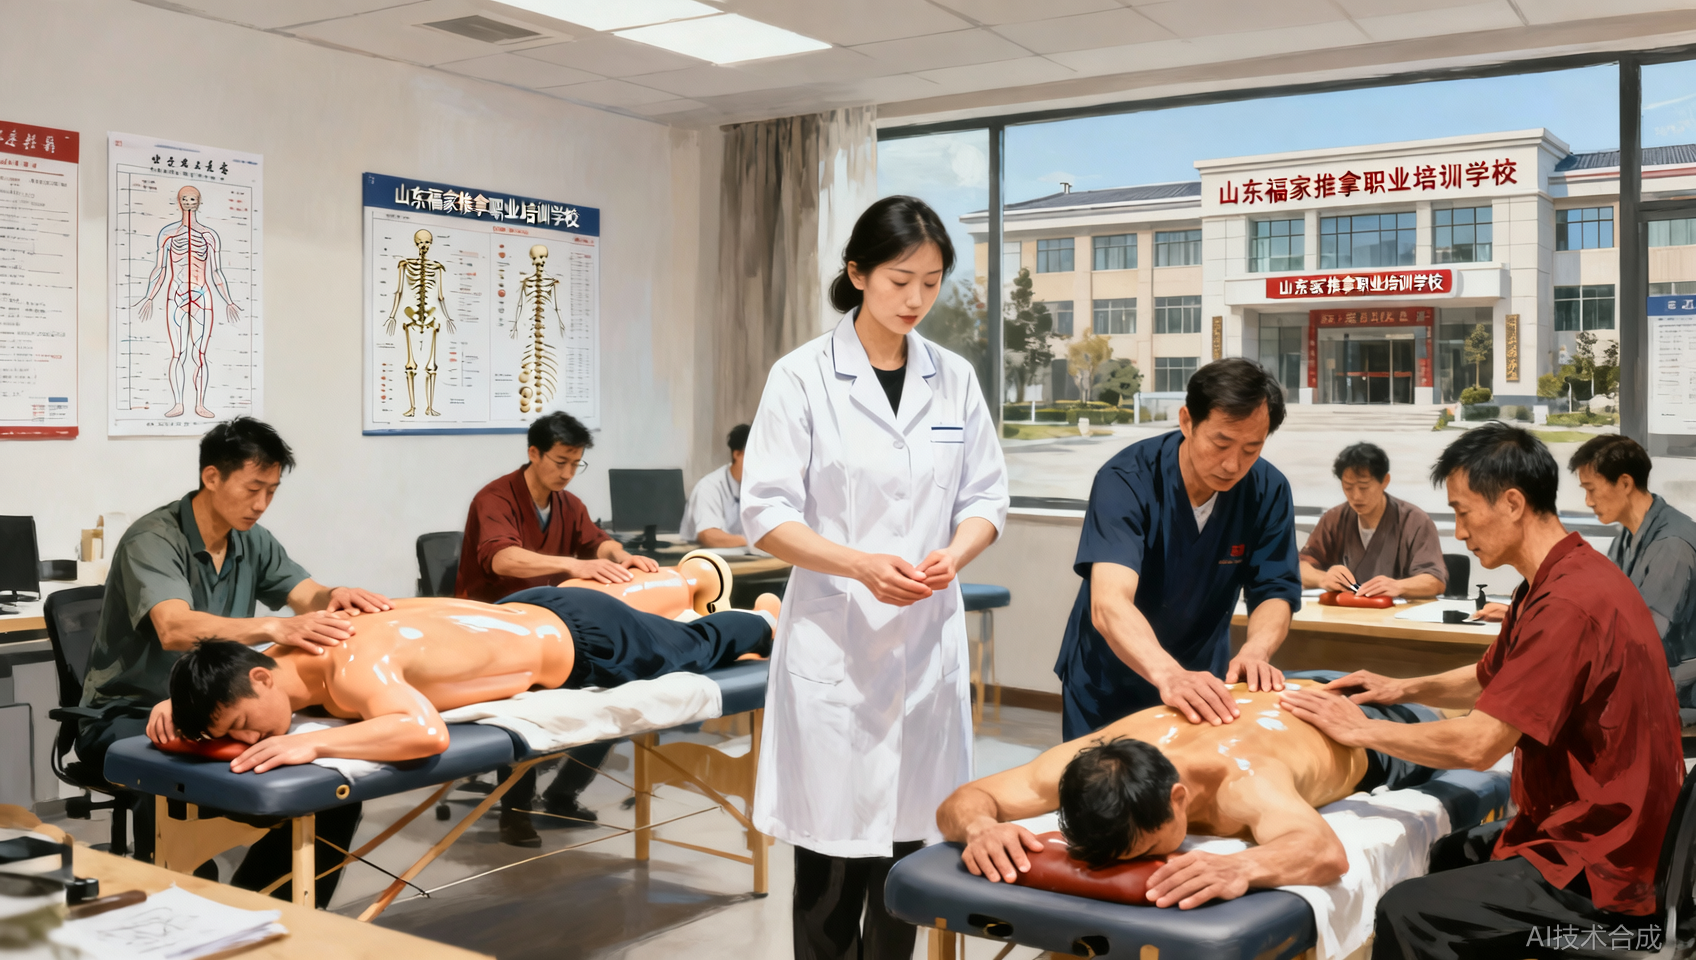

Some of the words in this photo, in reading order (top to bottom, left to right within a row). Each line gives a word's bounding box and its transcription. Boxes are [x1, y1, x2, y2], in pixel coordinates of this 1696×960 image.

[1219, 158, 1518, 205] 山东福家推拿职业培训学校
